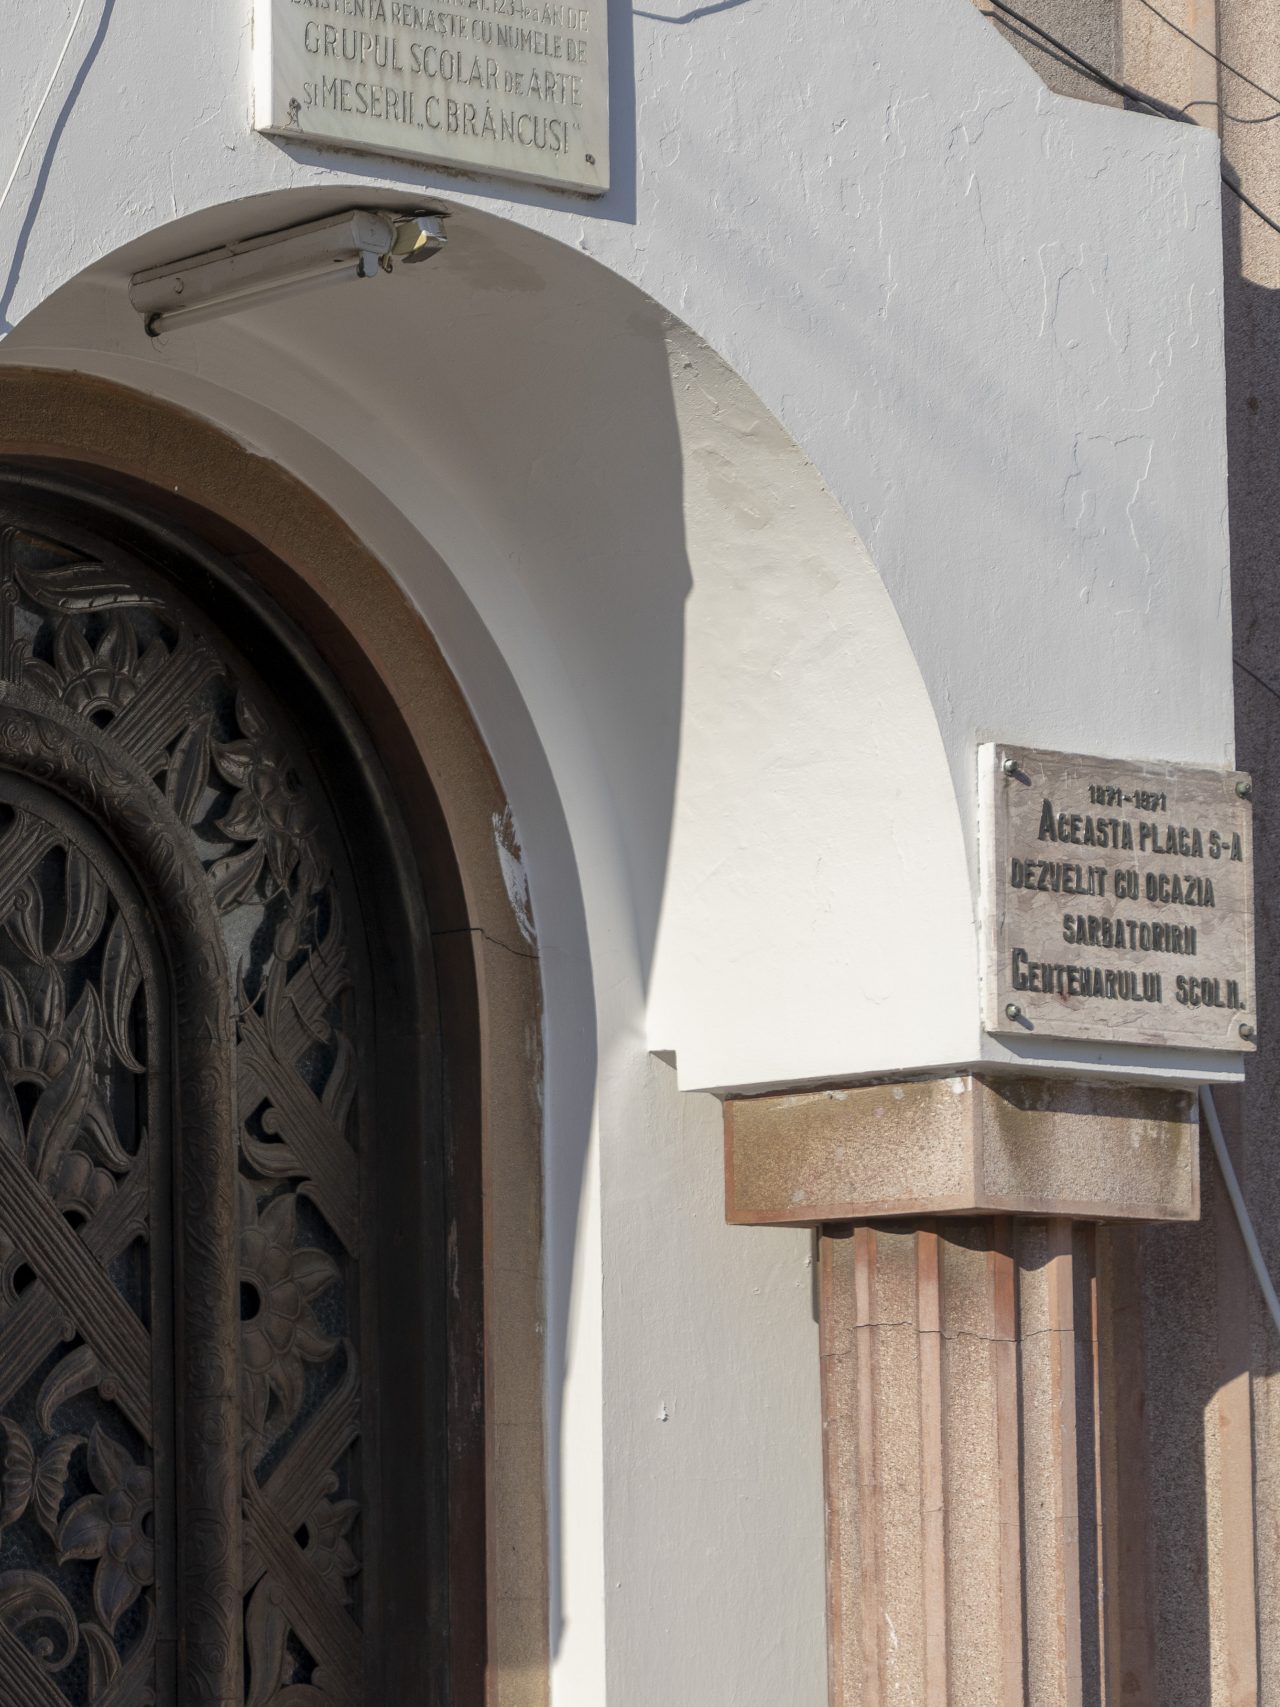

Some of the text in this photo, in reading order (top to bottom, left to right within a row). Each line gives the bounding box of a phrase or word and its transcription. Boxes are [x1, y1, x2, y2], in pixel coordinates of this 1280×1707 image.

[471, 19, 492, 44] CU
[497, 24, 562, 58] NUMELE
[566, 38, 587, 63] DE
[540, 3, 565, 26] AN
[568, 7, 588, 32] DE
[304, 21, 583, 107] GRUPUL SCOLAR DE ARTE
[321, 75, 414, 124] MESERII
[1038, 799, 1243, 862] ACEASTA PLACA S-A
[1011, 858, 1216, 907] DEZVELIT CU OCAZIA
[1063, 914, 1197, 956] SARBATORIRII
